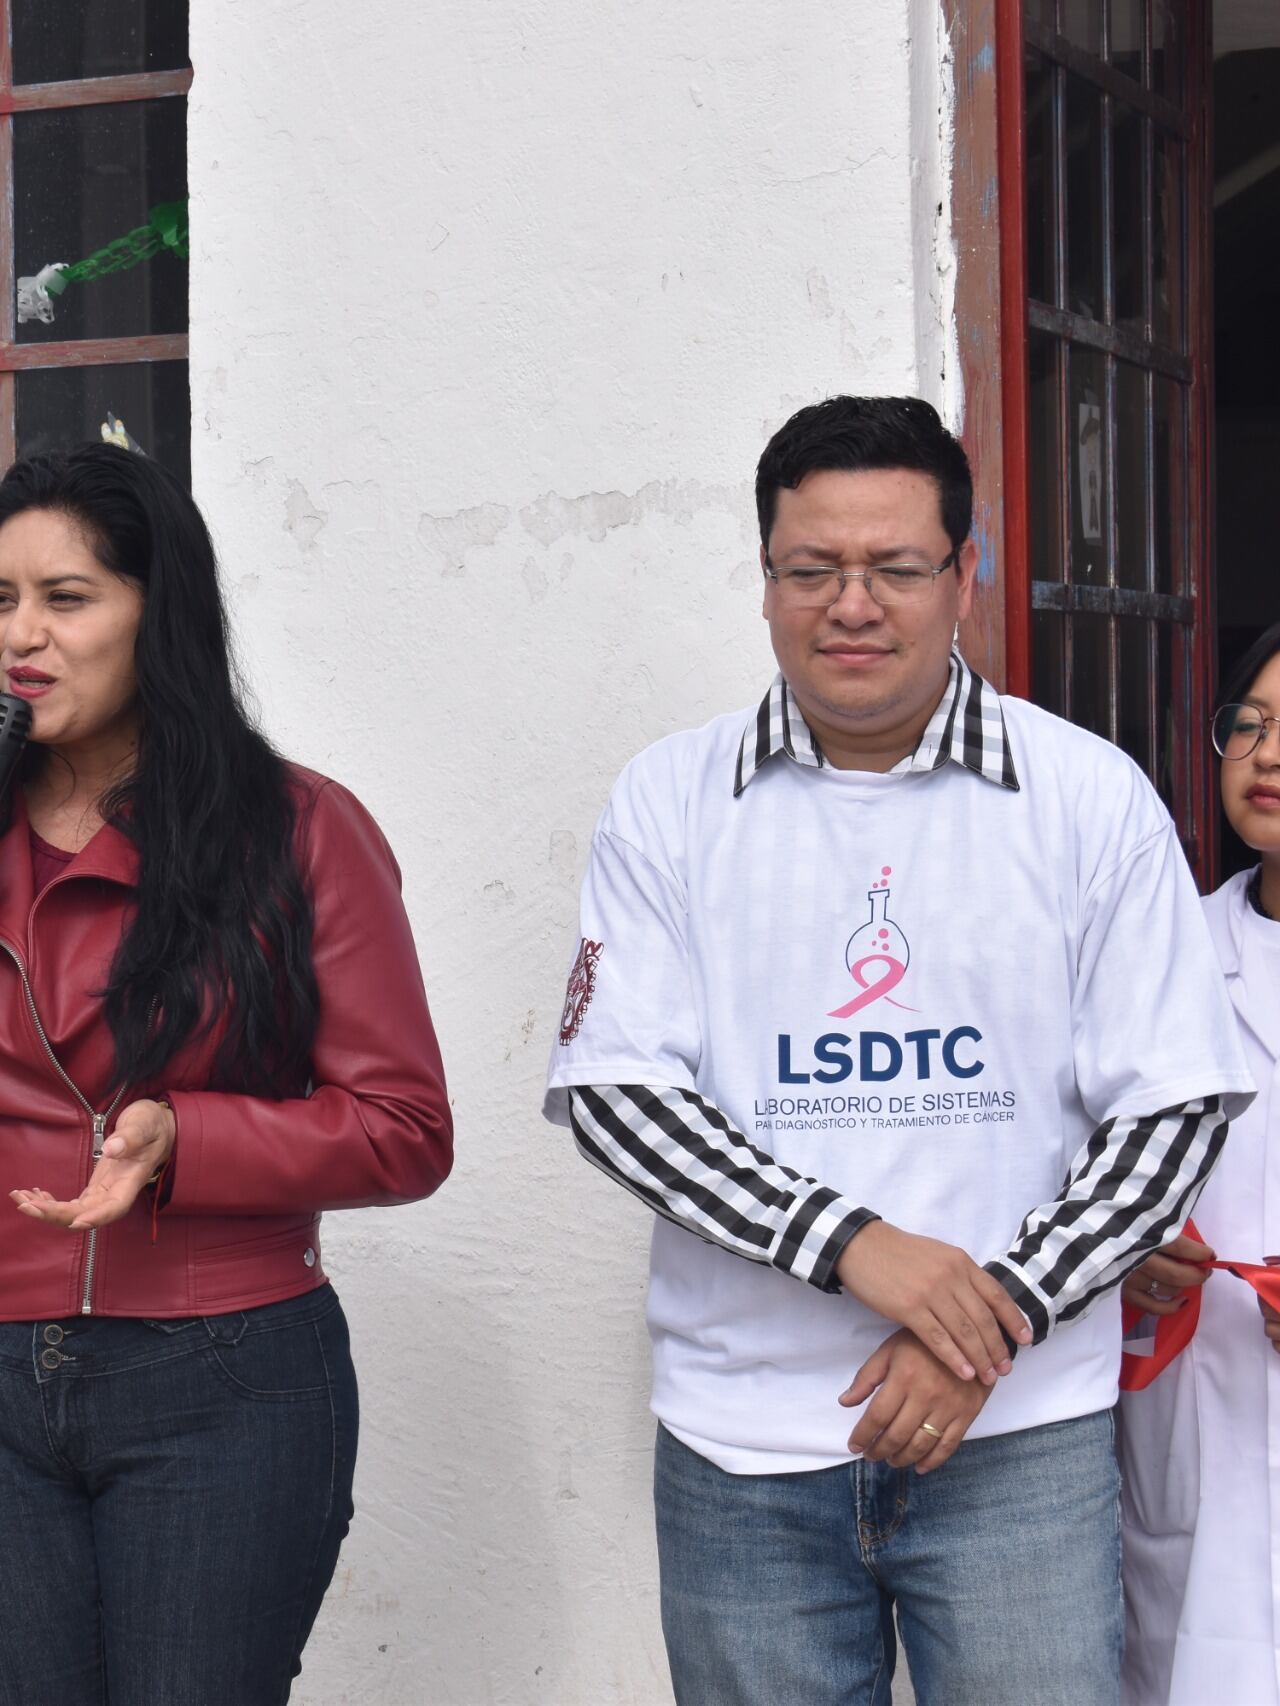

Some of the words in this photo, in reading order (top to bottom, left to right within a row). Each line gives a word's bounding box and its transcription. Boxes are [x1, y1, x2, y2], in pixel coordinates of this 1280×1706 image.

[777, 1025, 985, 1084] LSDTC
[889, 1096, 916, 1113] DE
[922, 1091, 1016, 1111] SISTEMAS
[859, 1118, 867, 1128] Y
[871, 1114, 951, 1129] TRATAMIENTO
[954, 1113, 970, 1124] DE
